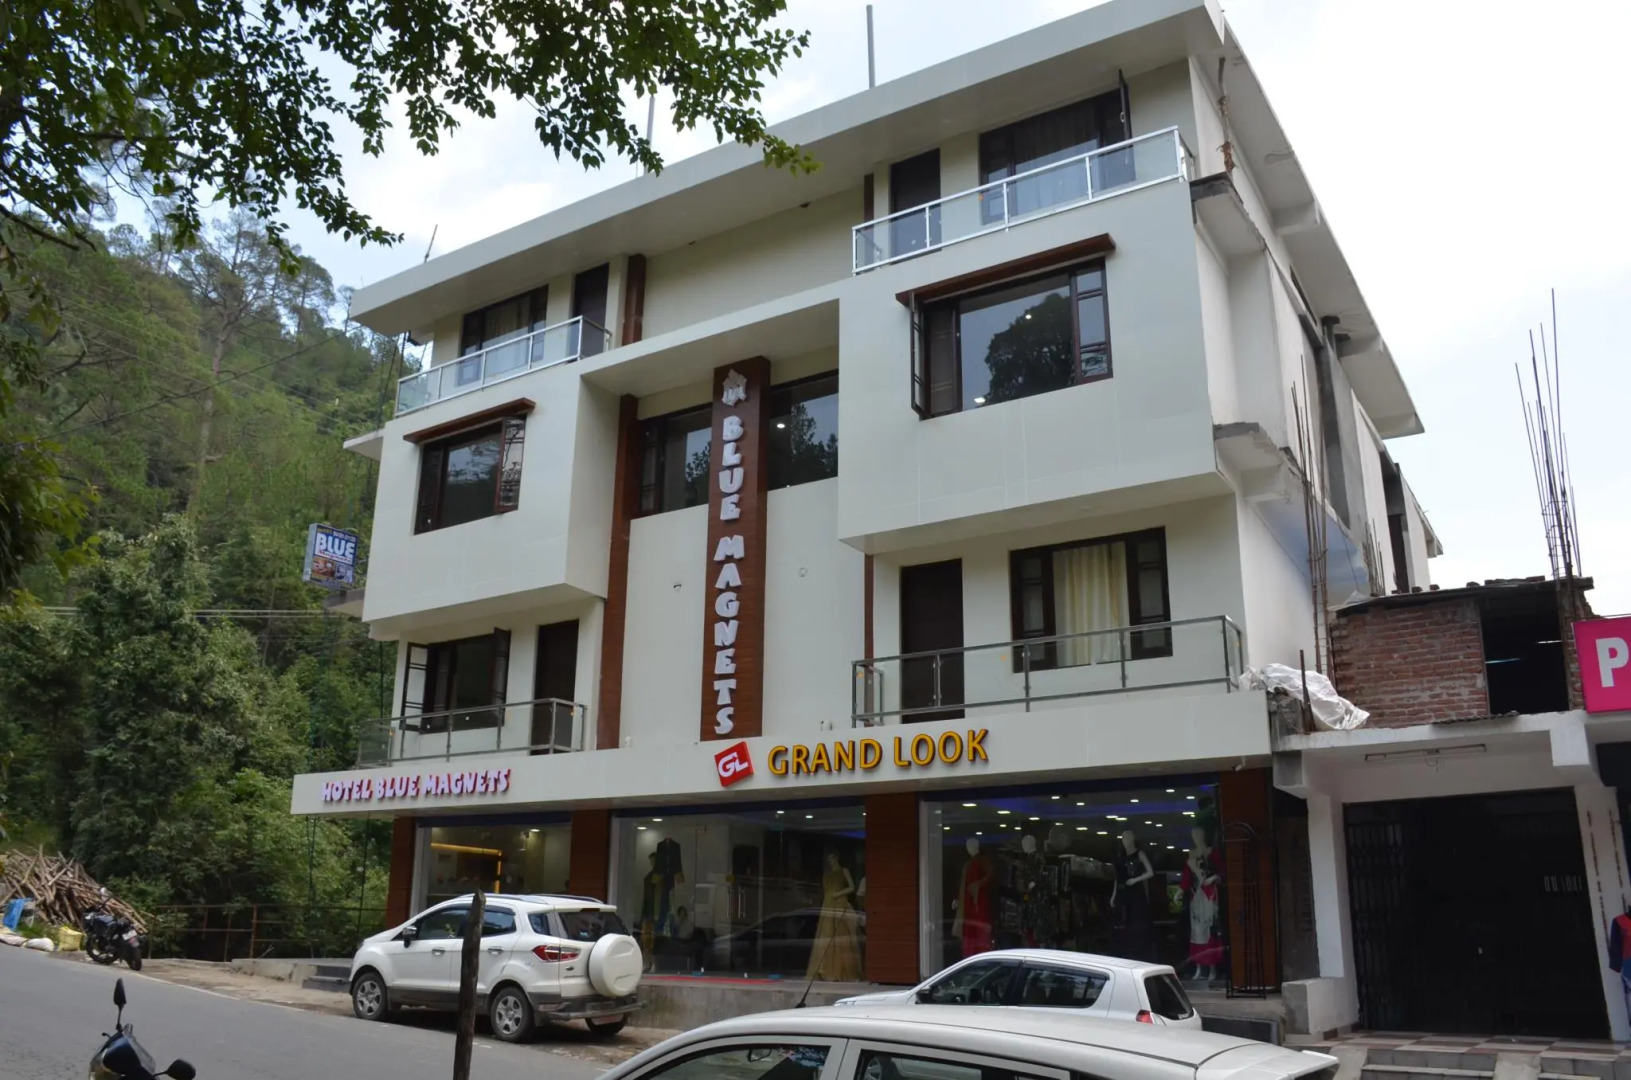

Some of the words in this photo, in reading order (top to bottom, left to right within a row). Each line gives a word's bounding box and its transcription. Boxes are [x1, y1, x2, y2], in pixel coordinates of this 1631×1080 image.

[718, 415, 744, 520] BLUE
[314, 532, 356, 560] BLUE
[713, 534, 745, 735] MAGNETS
[1595, 637, 1629, 688] P
[718, 751, 749, 778] GL
[768, 738, 883, 776] GRAND
[893, 728, 988, 767] LOOK
[322, 779, 373, 802] HOTEL
[375, 775, 420, 799] BLUE
[424, 768, 511, 796] MAGNETS
